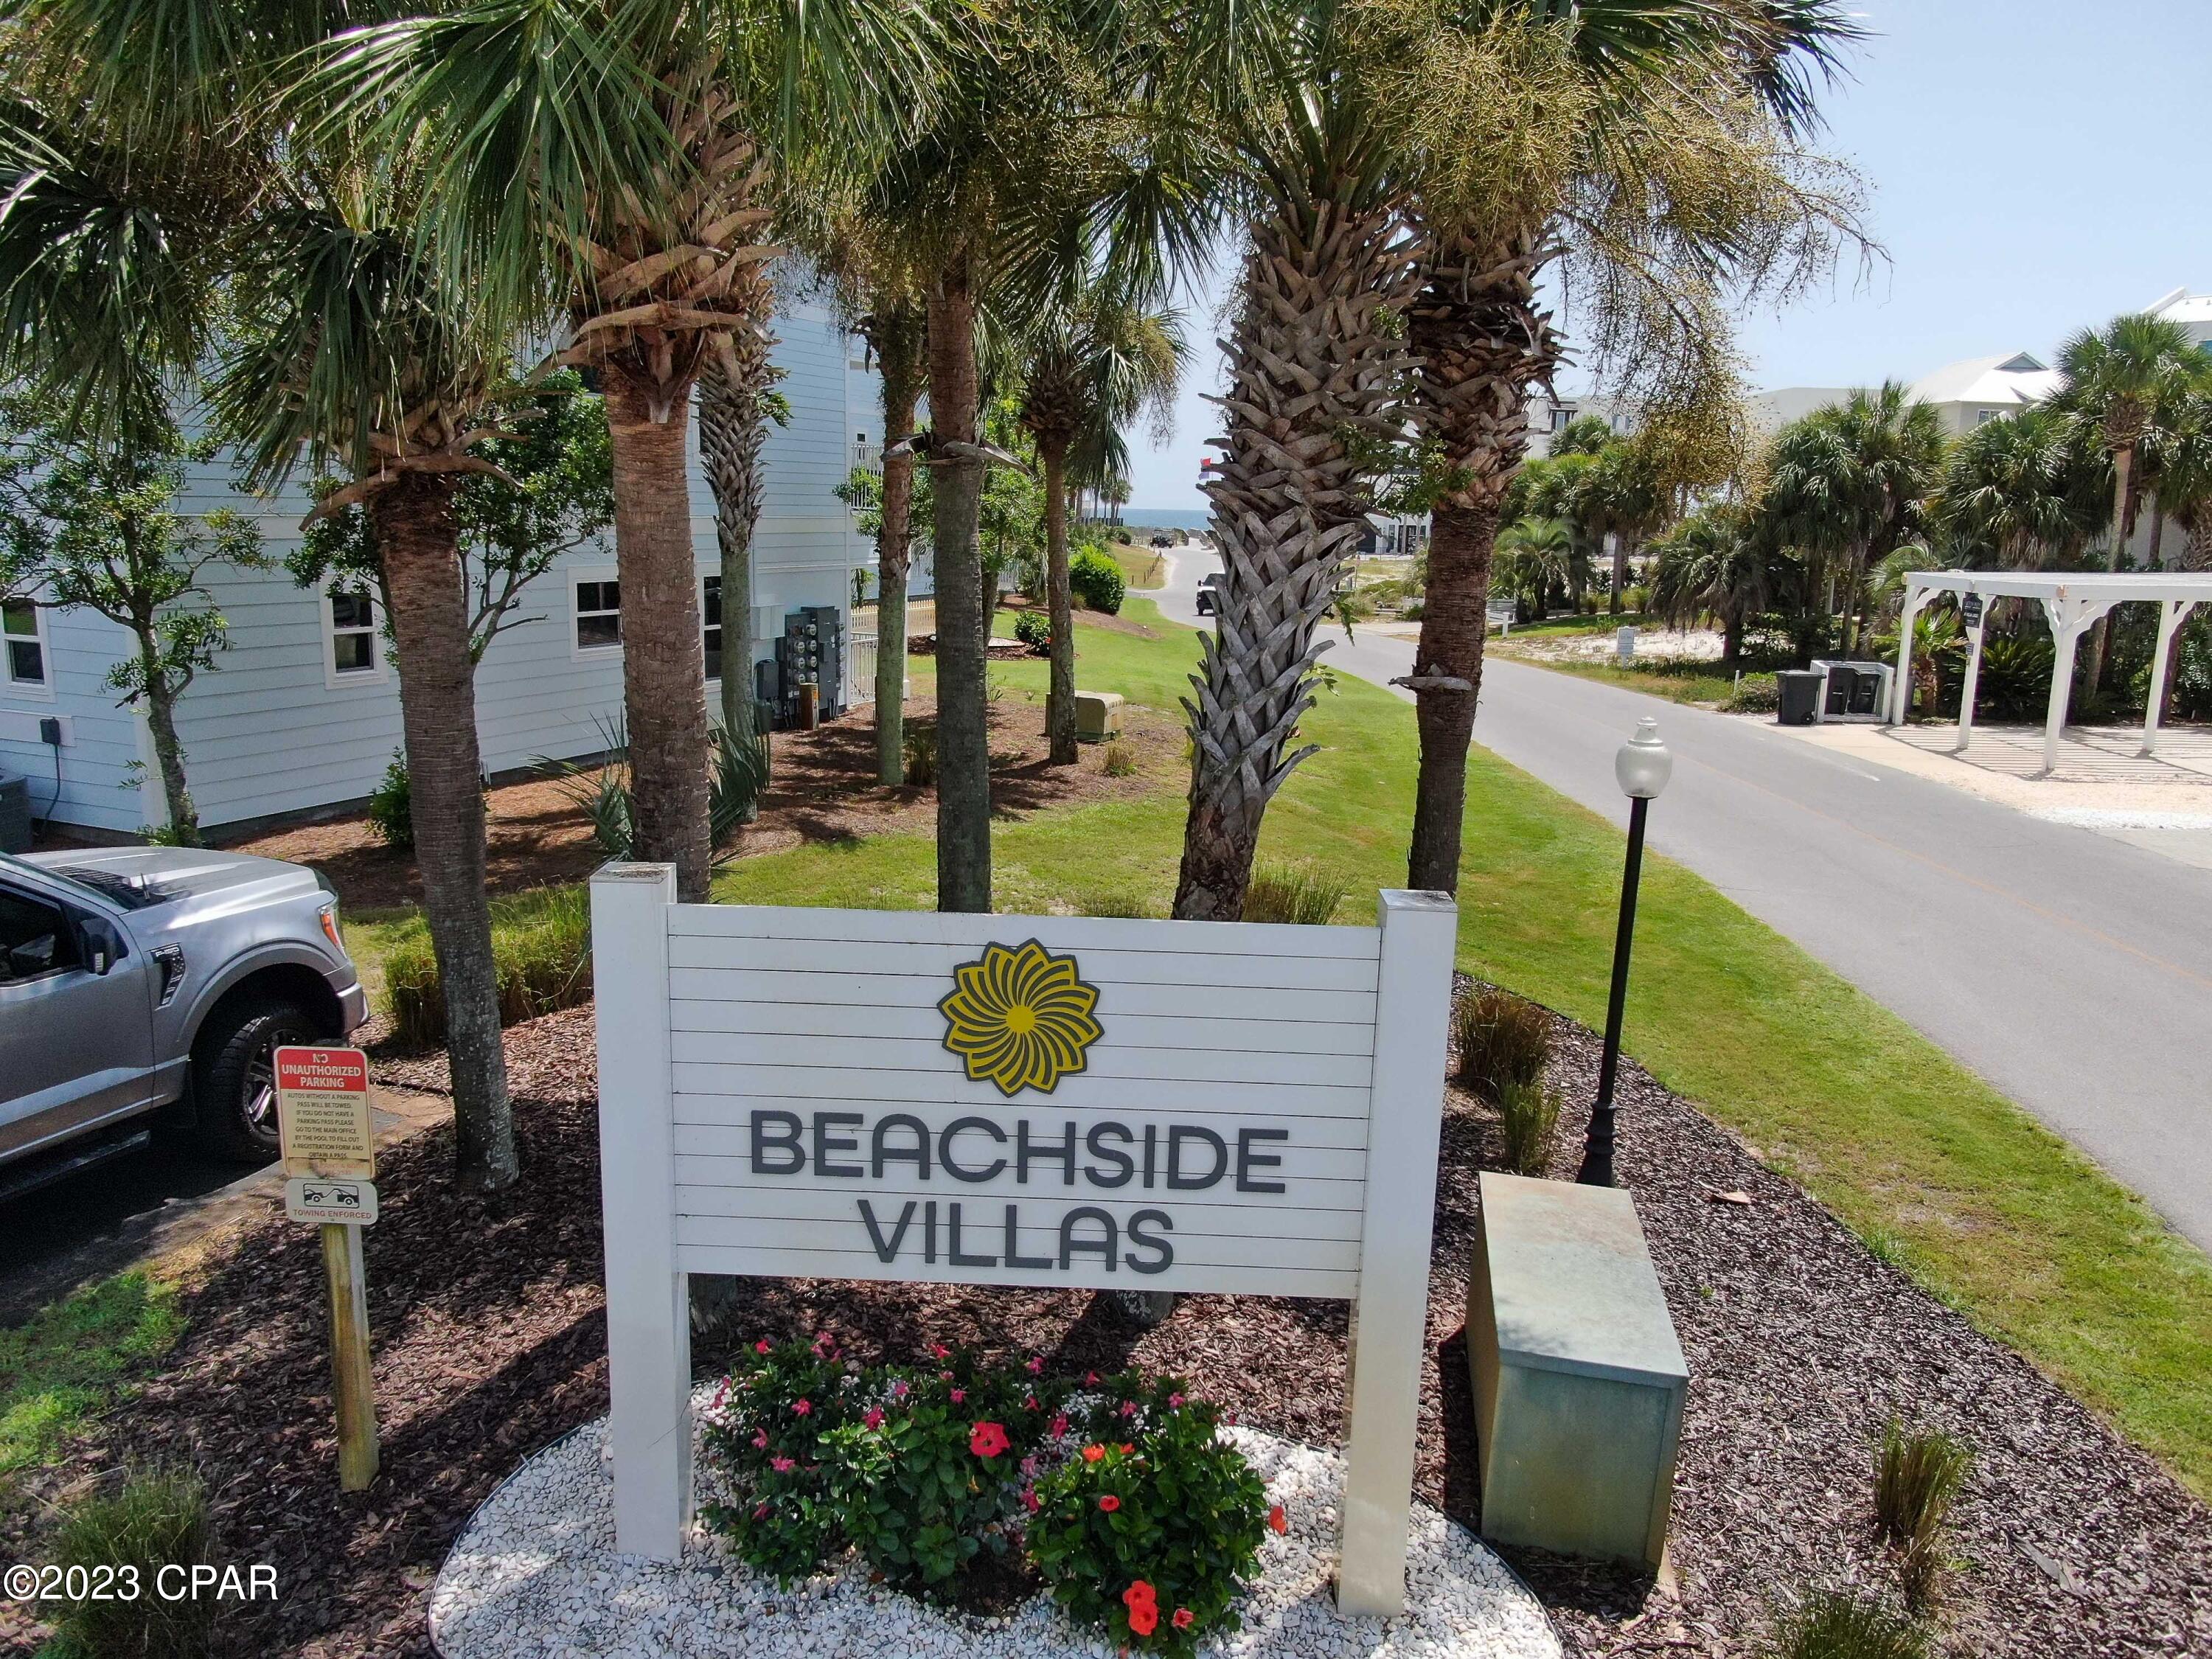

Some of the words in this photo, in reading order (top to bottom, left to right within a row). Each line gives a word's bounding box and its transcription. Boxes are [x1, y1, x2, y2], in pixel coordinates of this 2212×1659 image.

[313, 1054, 328, 1063] NO
[282, 1065, 361, 1076] UNAUTHORIZED
[300, 1077, 344, 1087] PARKING
[751, 1109, 1288, 1193] BEACHSIDE
[858, 1199, 1174, 1274] VILLAS
